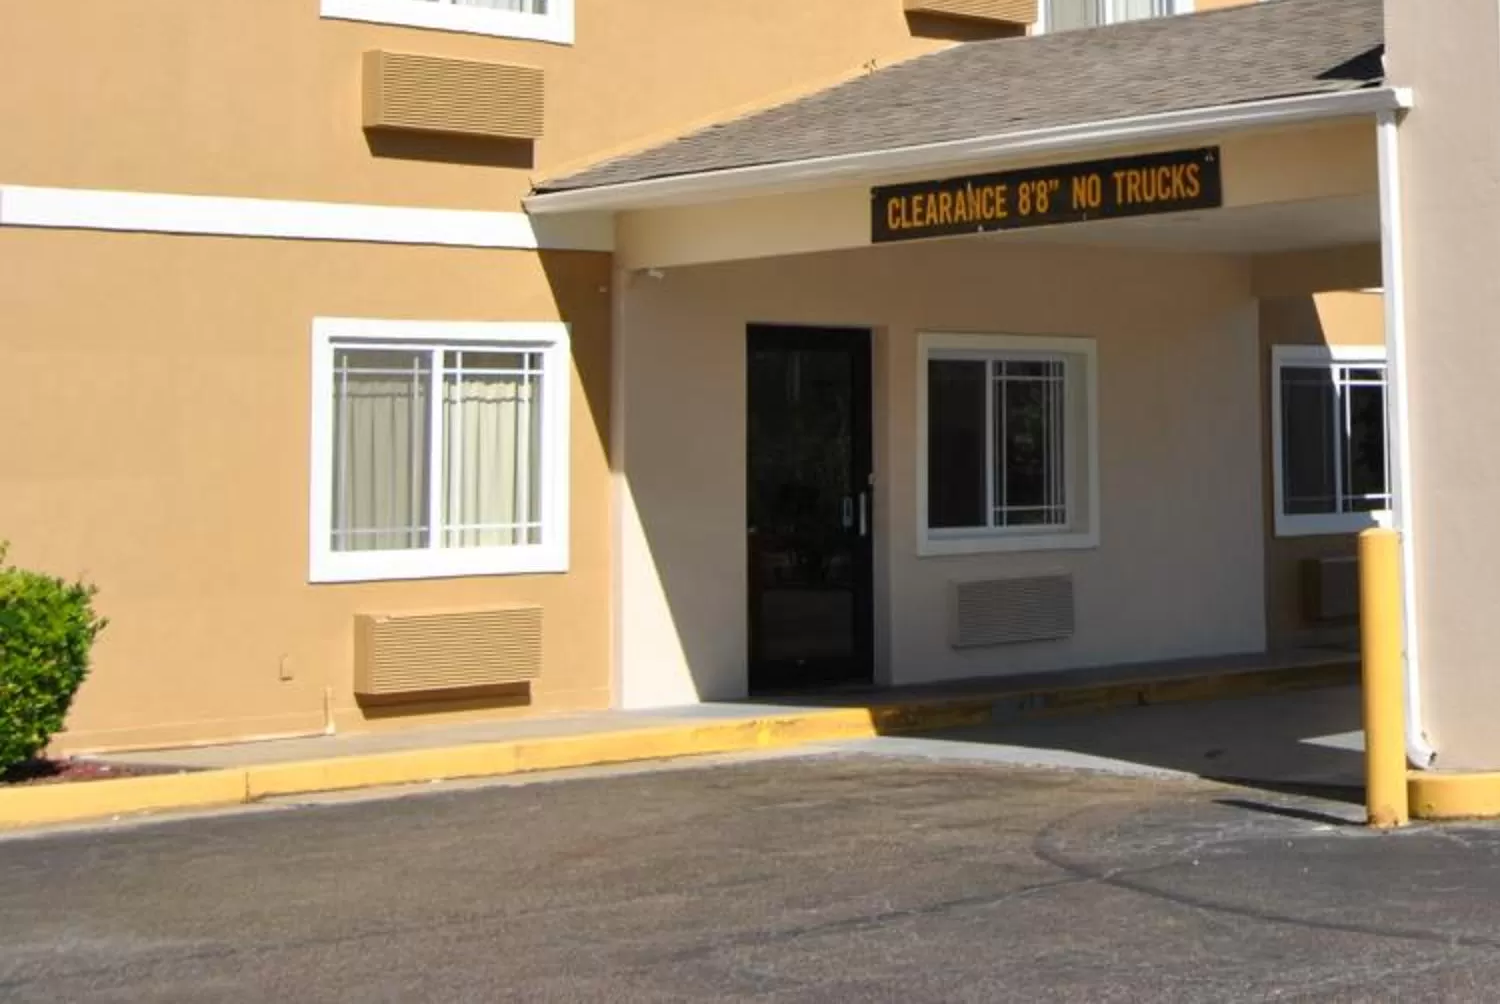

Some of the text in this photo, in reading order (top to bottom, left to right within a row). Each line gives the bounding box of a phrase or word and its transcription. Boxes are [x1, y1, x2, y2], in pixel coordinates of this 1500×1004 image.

[887, 184, 1008, 230] CLEARANCE
[1072, 175, 1102, 210] NO
[1113, 163, 1200, 206] TRUCKS
